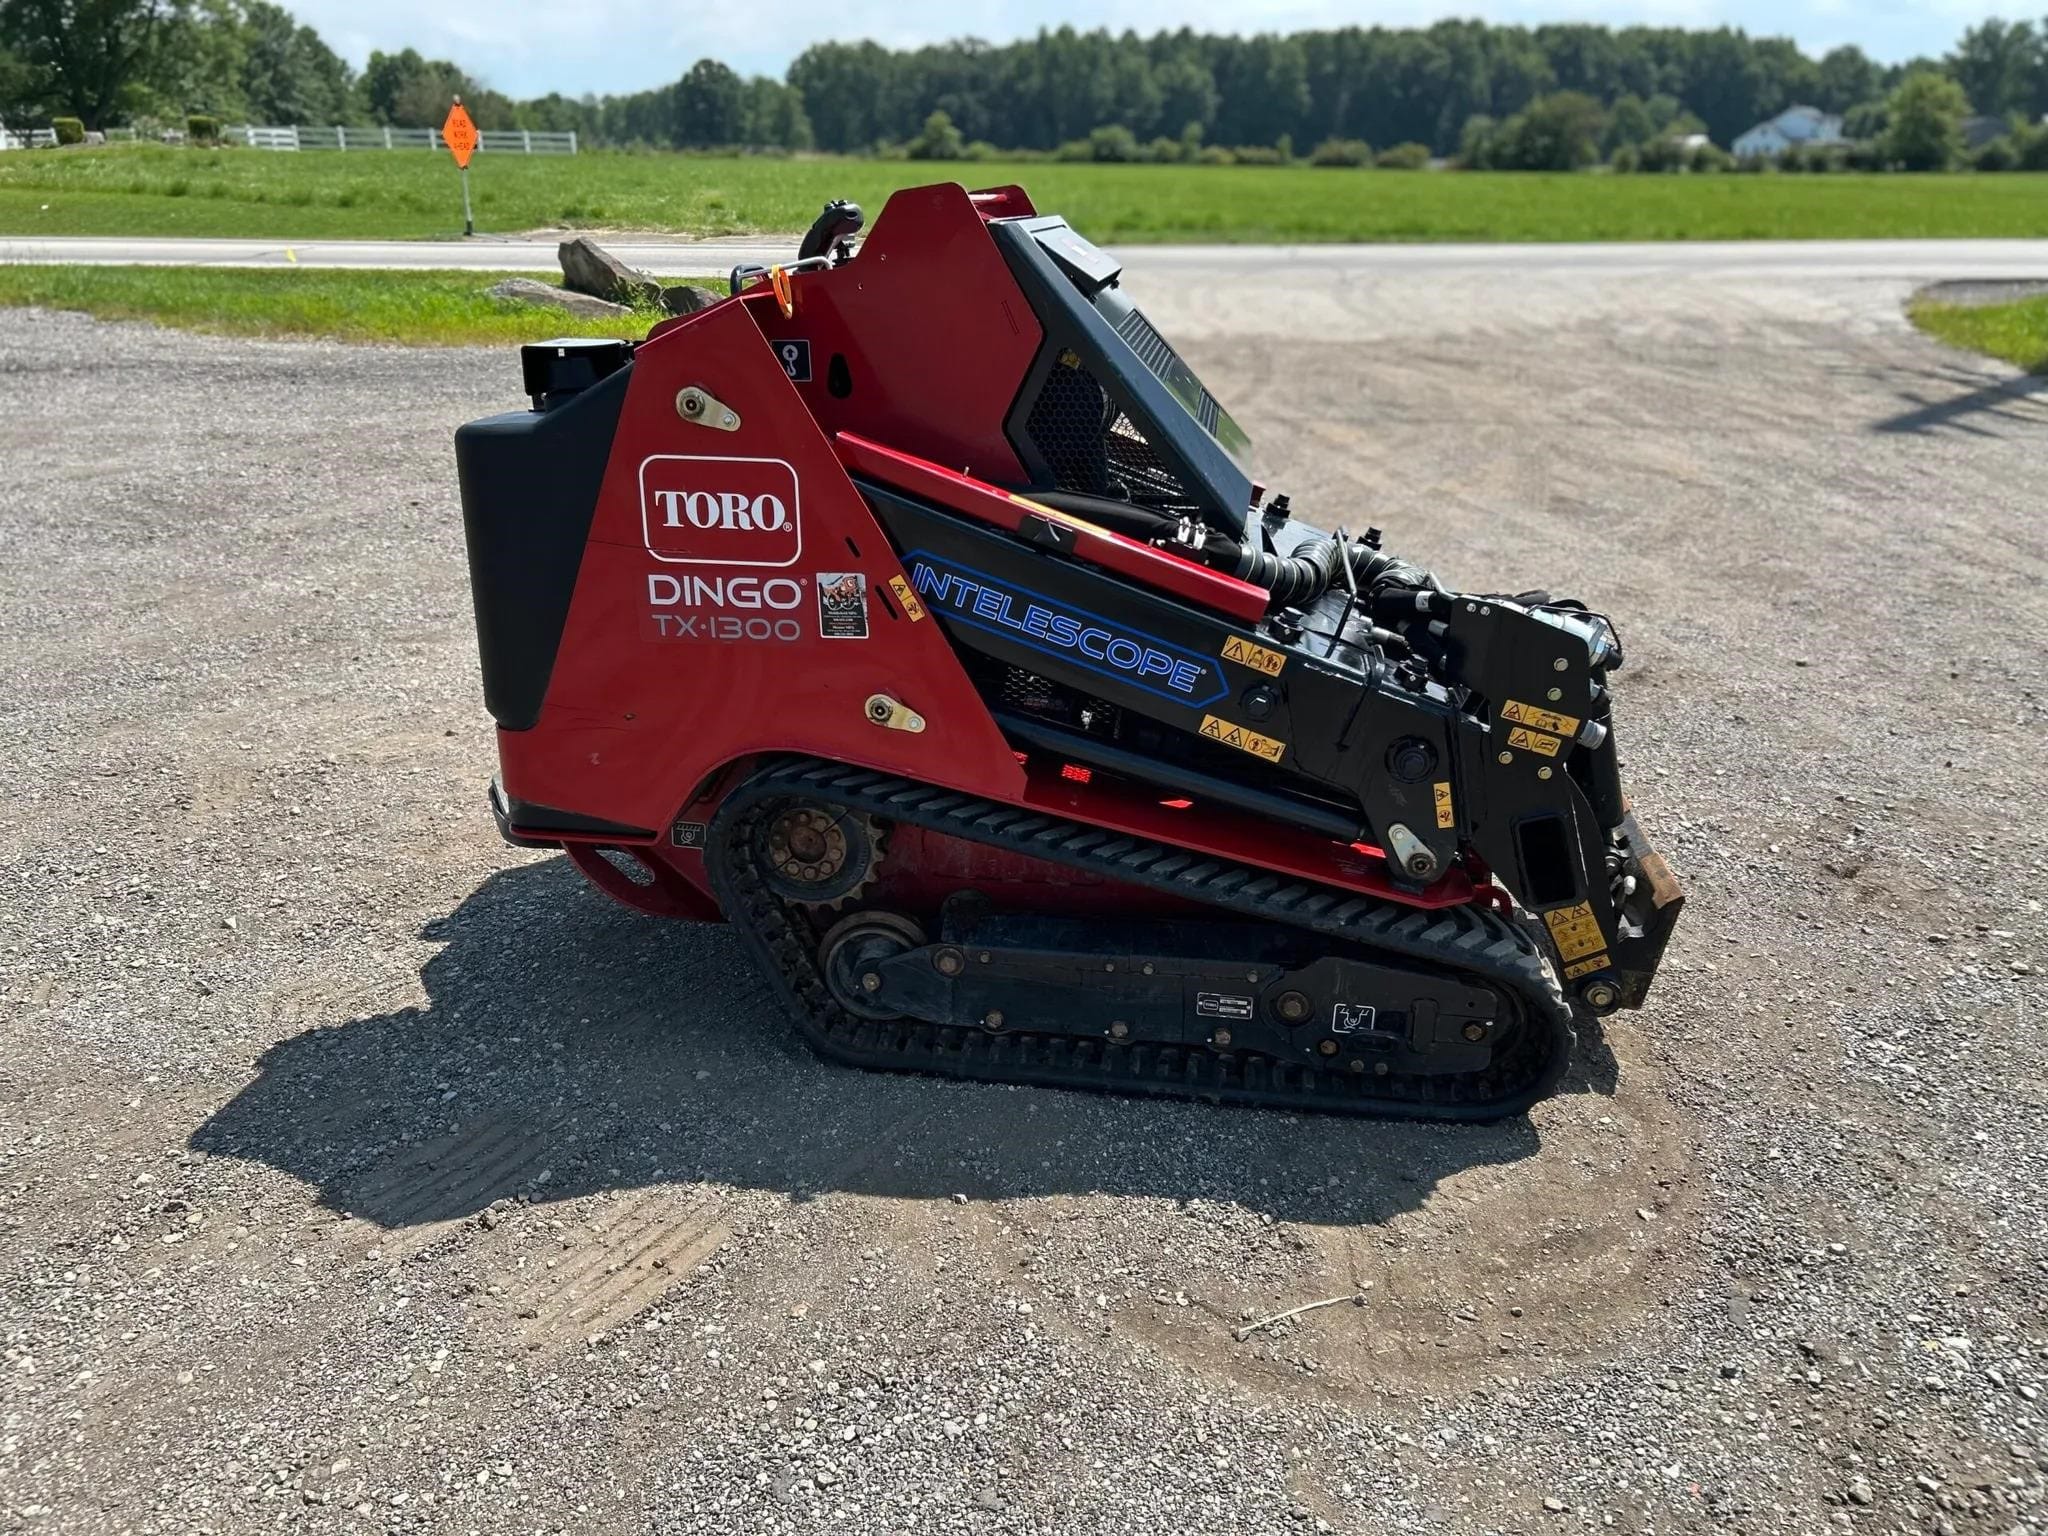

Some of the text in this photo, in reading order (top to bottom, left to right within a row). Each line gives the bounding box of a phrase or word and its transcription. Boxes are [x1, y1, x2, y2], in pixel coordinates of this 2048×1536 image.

[655, 491, 786, 532] TORO
[648, 574, 802, 609] DINGO
[912, 562, 1202, 694] INTELESCOPE
